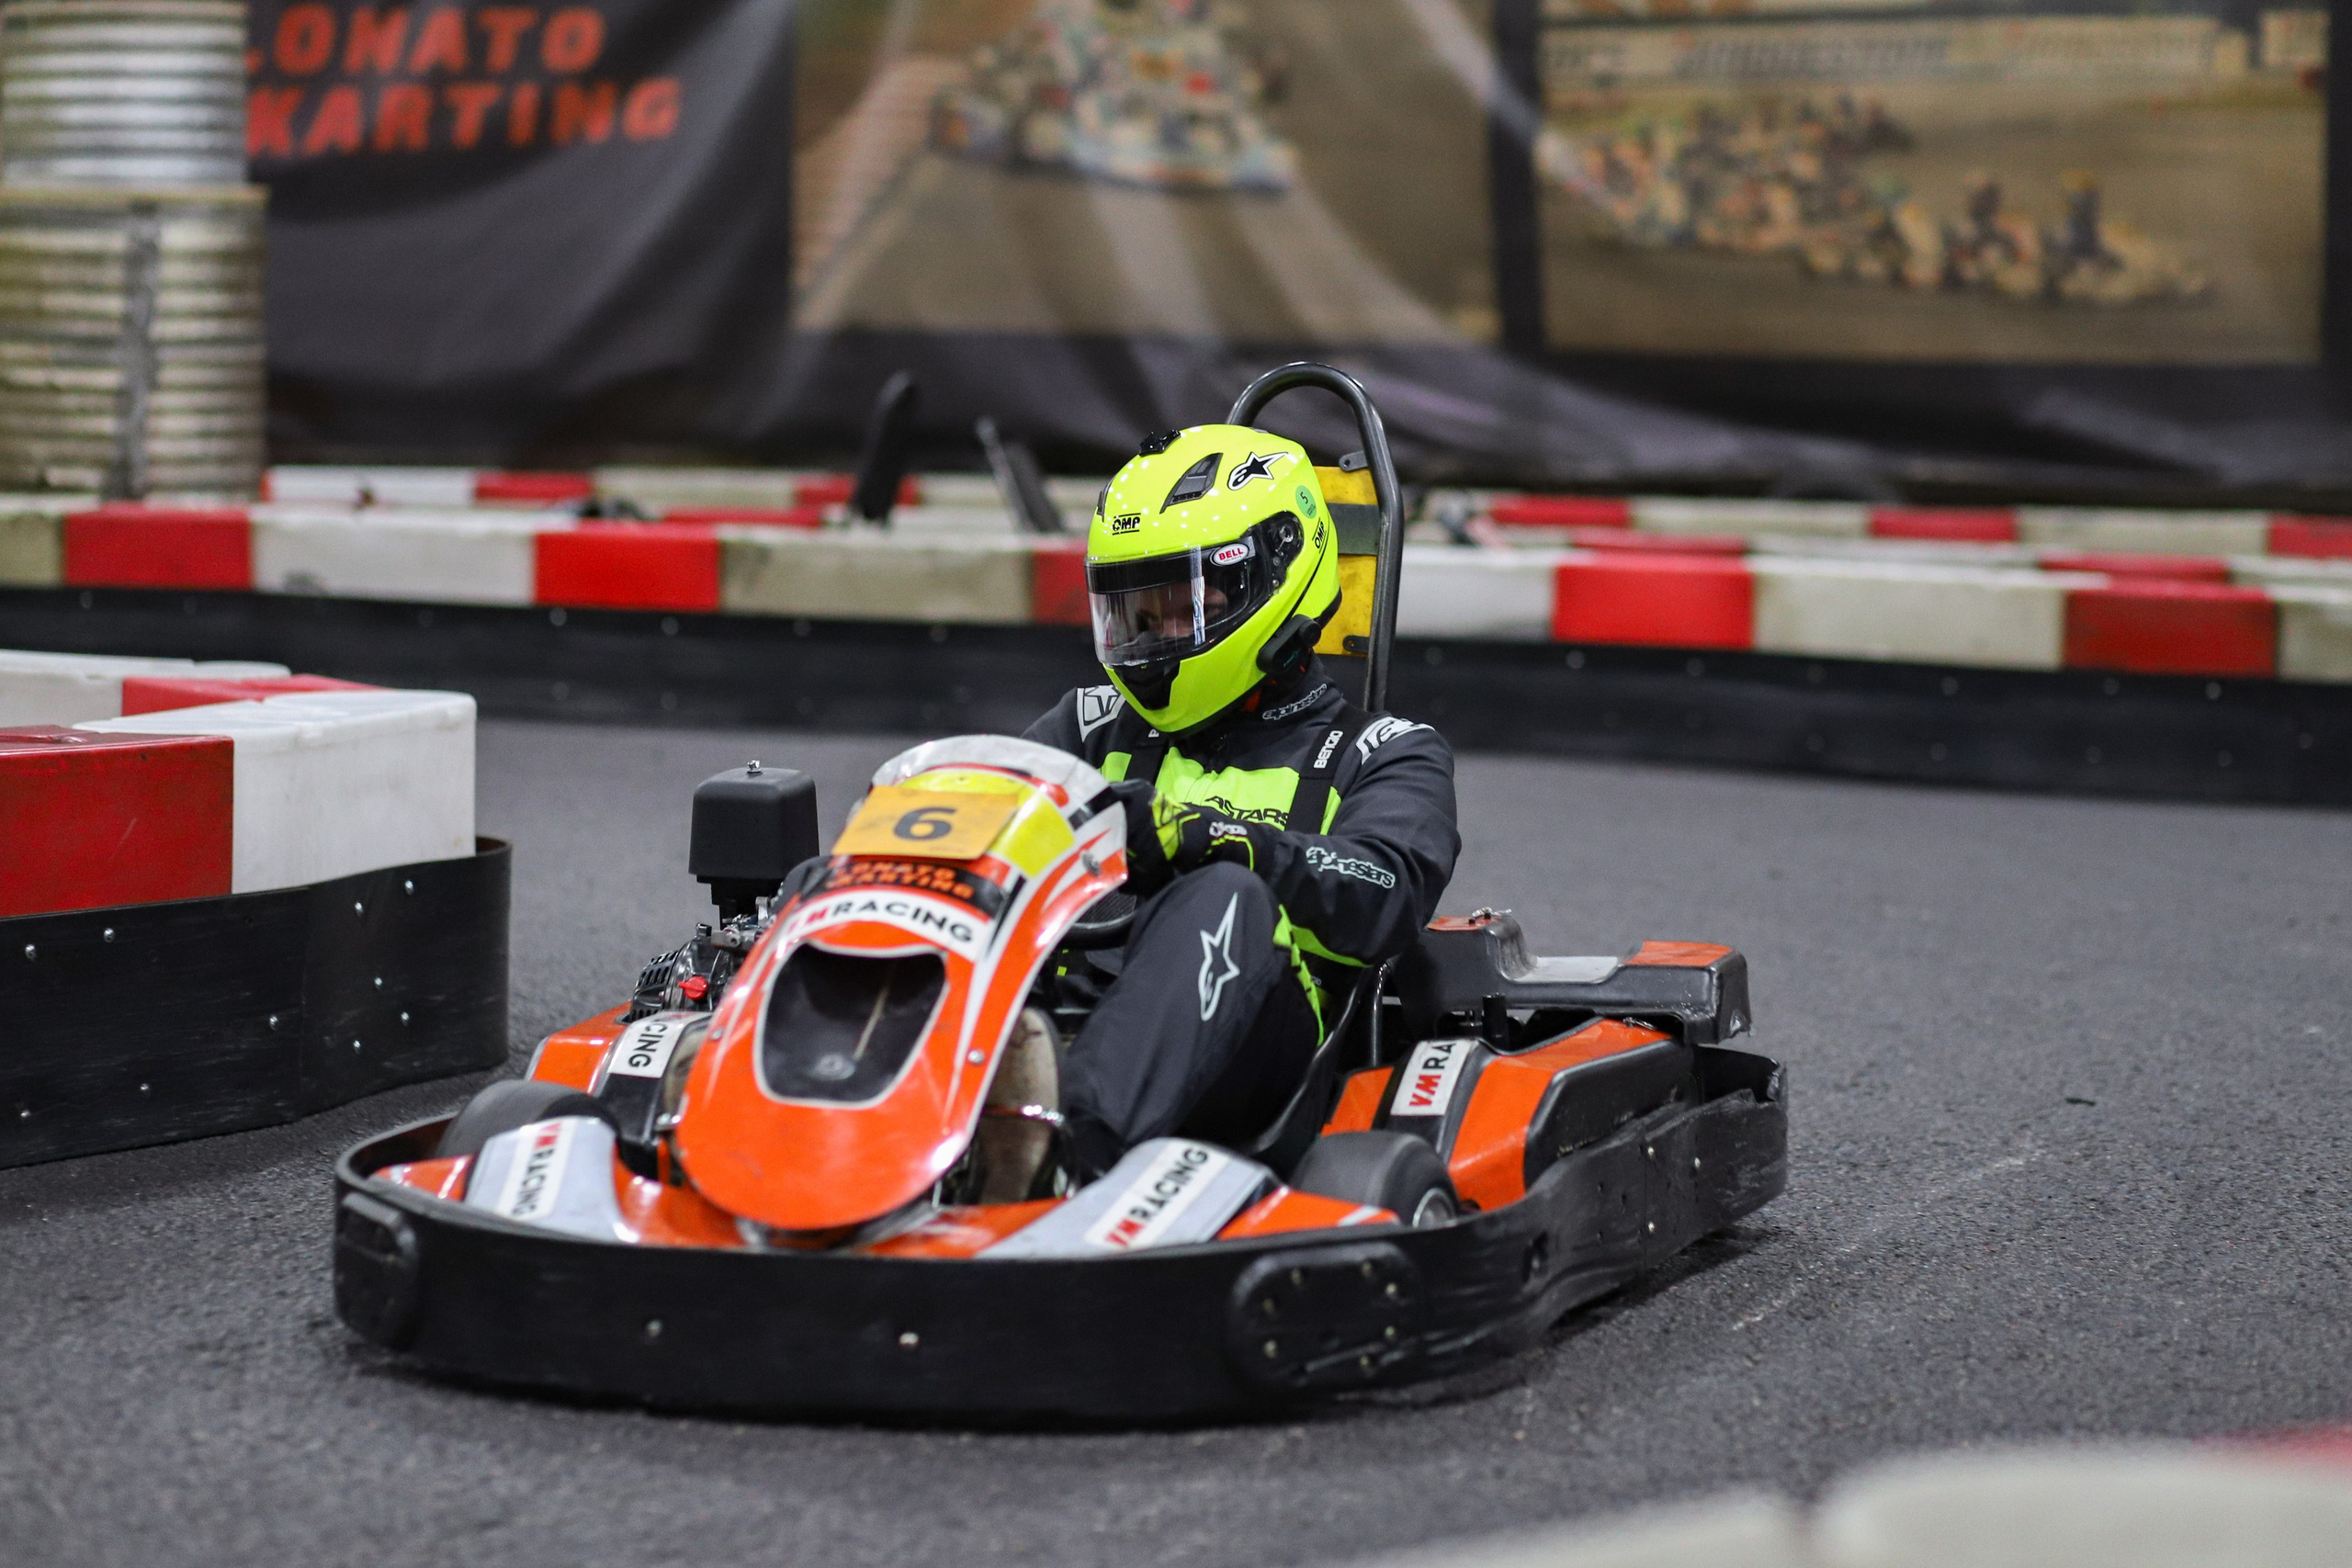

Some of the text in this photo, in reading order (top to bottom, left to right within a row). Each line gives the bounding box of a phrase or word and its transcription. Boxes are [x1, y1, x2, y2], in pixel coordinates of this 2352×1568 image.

[247, 79, 680, 156] KARTING
[1299, 491, 1308, 504] 5
[1112, 515, 1141, 532] OMP
[1315, 521, 1325, 549] OMP
[1218, 547, 1244, 560] BELL
[1313, 730, 1344, 769] BENGIO
[893, 807, 957, 841] 6
